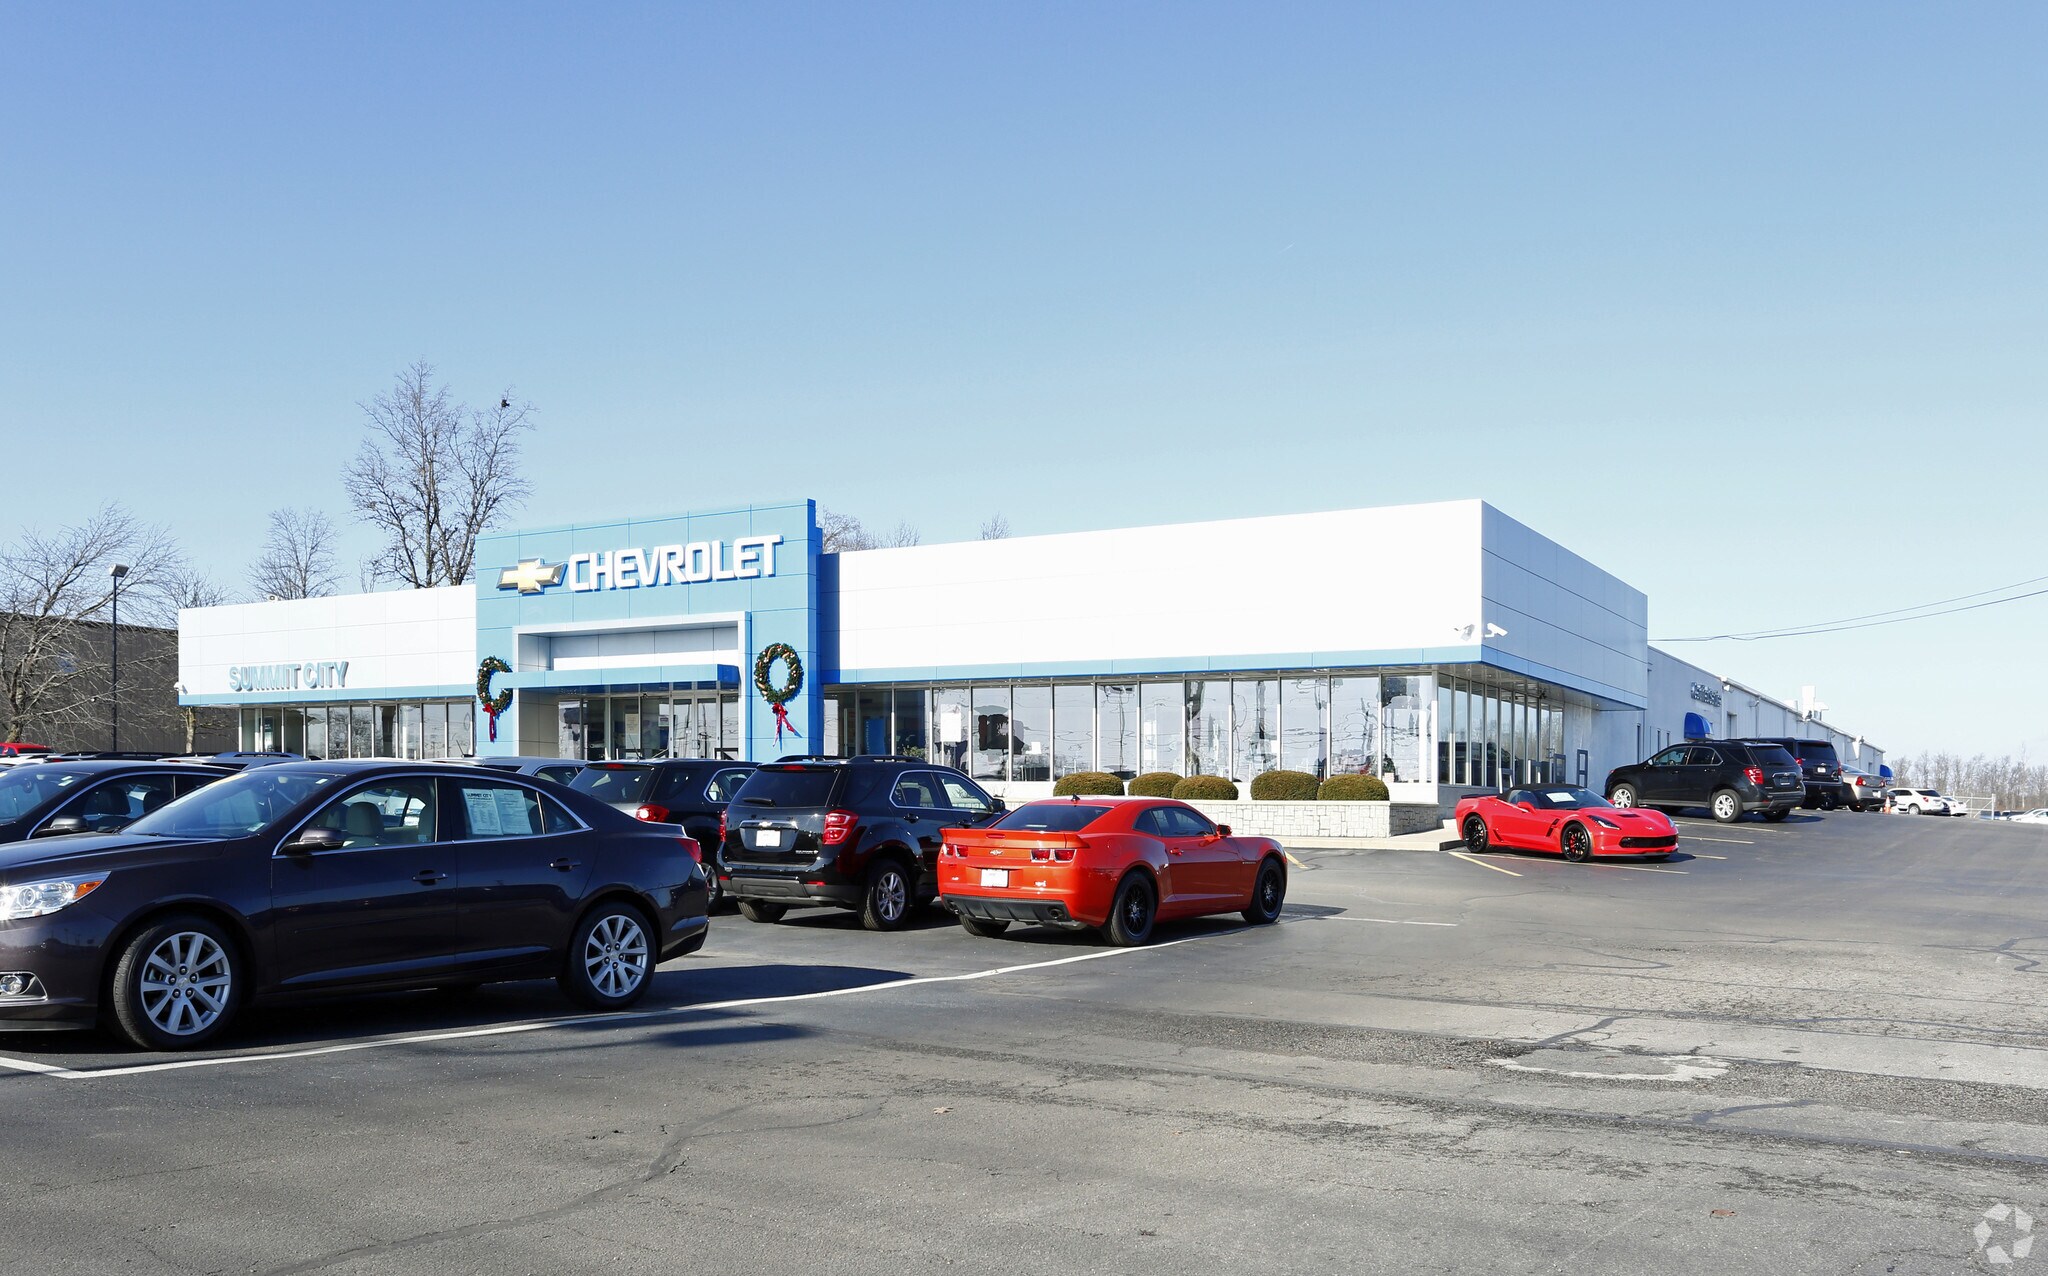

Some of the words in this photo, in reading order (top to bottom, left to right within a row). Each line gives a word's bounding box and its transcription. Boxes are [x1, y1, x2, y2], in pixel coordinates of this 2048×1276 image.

[568, 534, 783, 593] CHEVROLET
[229, 664, 301, 692] SUMMIT
[303, 661, 349, 689] CITY
